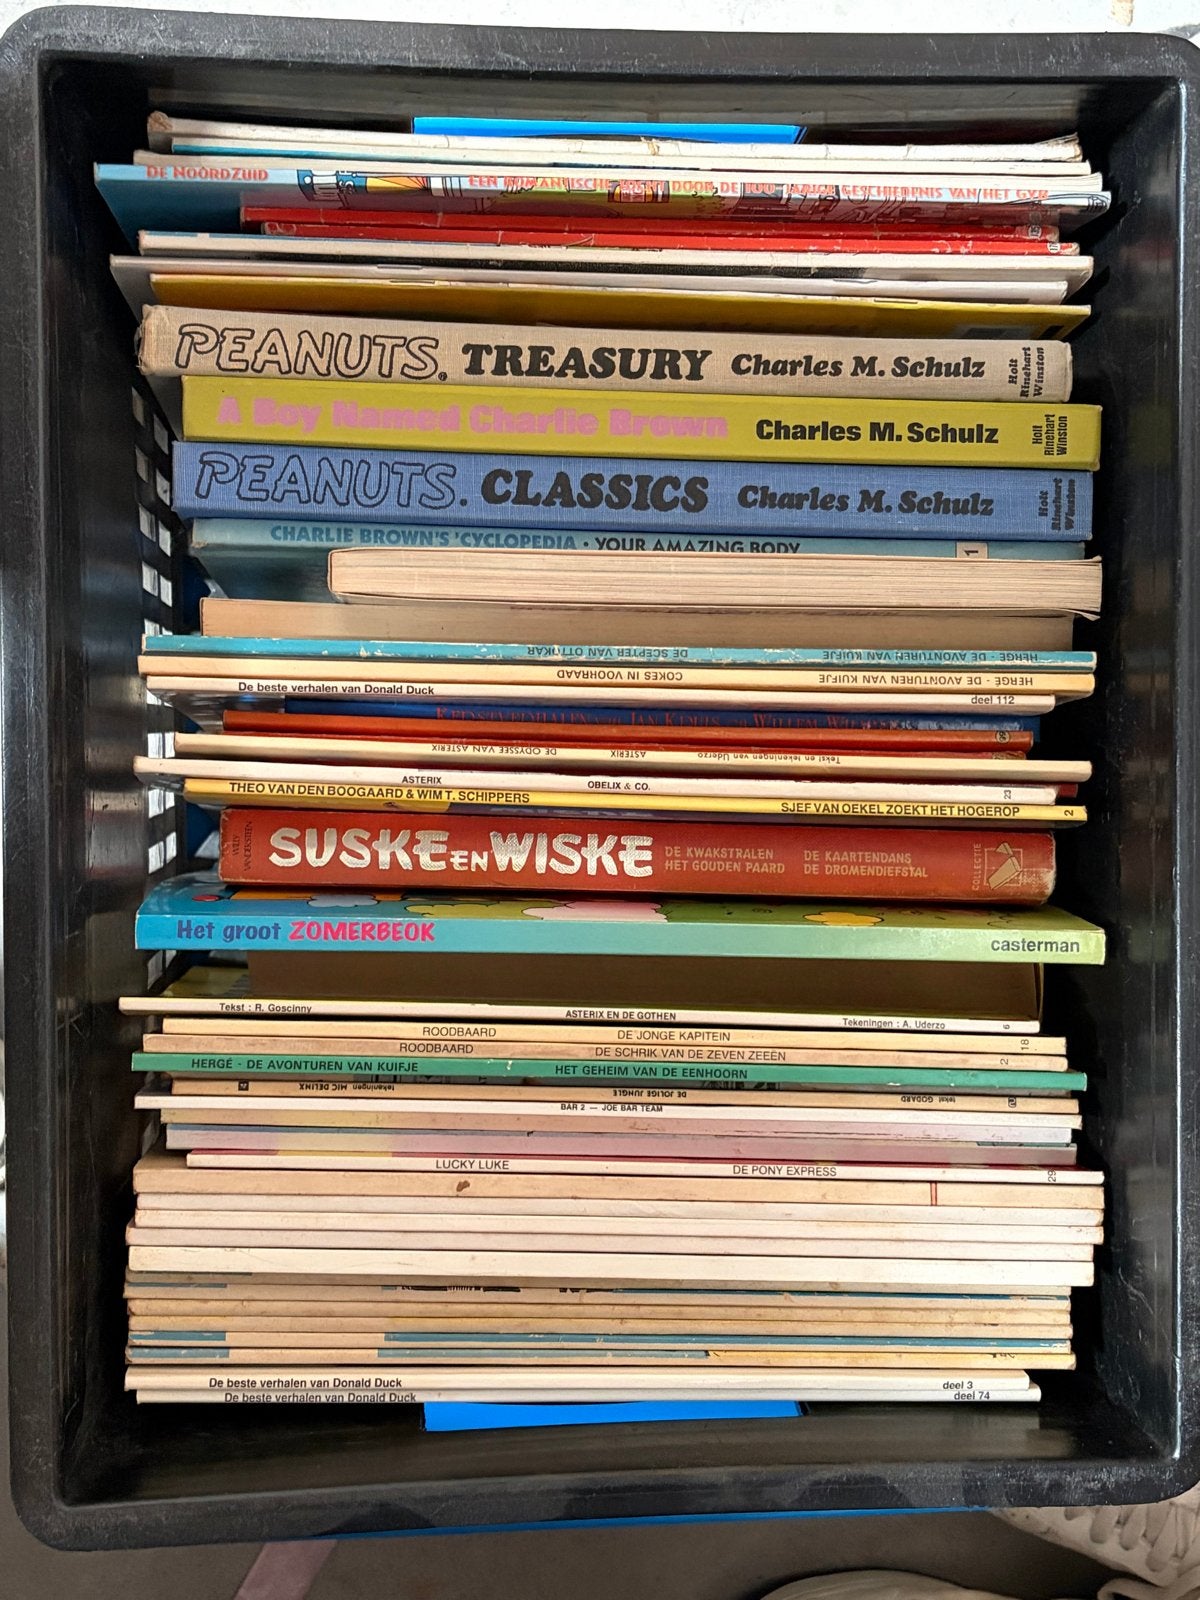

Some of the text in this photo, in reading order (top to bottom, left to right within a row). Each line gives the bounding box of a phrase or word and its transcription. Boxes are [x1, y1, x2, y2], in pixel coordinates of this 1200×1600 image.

[468, 175, 497, 187] EEN
[504, 176, 611, 190] ROMANTISCHE
[672, 181, 714, 193] DOOR
[720, 182, 739, 193] DE
[949, 187, 977, 199] VAN
[983, 188, 1009, 199] HET
[461, 343, 713, 381] TREASURY
[731, 353, 843, 378] Charles
[850, 356, 885, 377] M.
[890, 356, 986, 378] Schulz
[1008, 358, 1018, 385] Holt
[1019, 346, 1031, 398] Rinehart
[1032, 347, 1044, 398] Winston
[217, 396, 999, 444] A Boy Named Charlie Brown Charles M. Schulz
[1032, 425, 1043, 445] Holt
[1044, 414, 1055, 456] Rinehart
[1056, 416, 1068, 456] Winston
[481, 468, 709, 513] CLASSICS
[737, 485, 850, 511] Charles
[857, 489, 892, 513] M.
[898, 490, 994, 516] Schulz
[271, 524, 354, 543] CHARLIE
[360, 527, 449, 547] BROWN'S
[595, 537, 646, 551] YOUR
[653, 538, 744, 553] AMAZING
[750, 541, 801, 554] BODY
[557, 669, 683, 681] COKES IN VOORRAAD
[819, 674, 1033, 688] HERGÉ DE AVONTUREN VAN KUIFJE
[238, 682, 254, 692] De
[257, 682, 288, 692] beste
[291, 683, 338, 693] verhalen
[364, 684, 403, 694] Donald
[407, 685, 434, 695] Duck
[971, 694, 1015, 705] deel 112
[431, 744, 557, 756] DE ODYSSEE VAN ASTERIX
[610, 750, 646, 758] ASTERIX
[401, 776, 442, 785] ASTERIX
[229, 782, 530, 803] THEO VAN DEN BOOGAARD & WIM T. SCHIPPERS
[1004, 790, 1012, 800] 23
[781, 802, 1020, 817] SJEF VAN OEKEL ZOEKT HET HOGEROP
[268, 827, 654, 877] SUSKE EN WISKE
[665, 846, 773, 860] DE KWAKSTRALEN
[804, 850, 912, 864] DE KAARTENDANS
[665, 860, 785, 874] HET GOUDEN PAARD
[804, 863, 928, 878] DE DROMENDIEFSTAL
[177, 920, 436, 943] Het groot ZOMERBEOK
[991, 938, 1080, 953] casterman
[219, 1003, 312, 1014] Tekst R. Goscinny
[565, 1010, 676, 1021] ASTERIX EN DE GOTHEN
[842, 1017, 946, 1030] Tekeningen A. Uderzo
[422, 1026, 497, 1037] ROODBAARD
[617, 1030, 731, 1042] DE JONGE KAPITEIN
[400, 1042, 474, 1054] ROODBAARD
[1021, 1039, 1029, 1050] 18
[595, 1047, 611, 1057] DE
[614, 1047, 658, 1058] SCHRIK
[661, 1048, 685, 1059] VAN
[688, 1049, 704, 1059] DE
[707, 1050, 745, 1060] ZEVEN
[191, 1057, 418, 1072] HERGÉ DE AVONTUREN VAN KUIFJE
[555, 1065, 748, 1079] HET GEHEIM VAN DE EENHOORN
[613, 1089, 644, 1097] JUNGLE
[647, 1090, 674, 1098] JOLIGE
[560, 1103, 578, 1111] BAR
[621, 1104, 638, 1112] BAR
[436, 1159, 509, 1170] LUCKY LUKE
[733, 1165, 837, 1177] DE PONY EXPRESS
[1048, 1169, 1056, 1182] 29
[209, 1378, 402, 1388] De beste verhalen van Donald Duck
[943, 1381, 973, 1389] deel 3
[954, 1391, 990, 1400] deel 74
